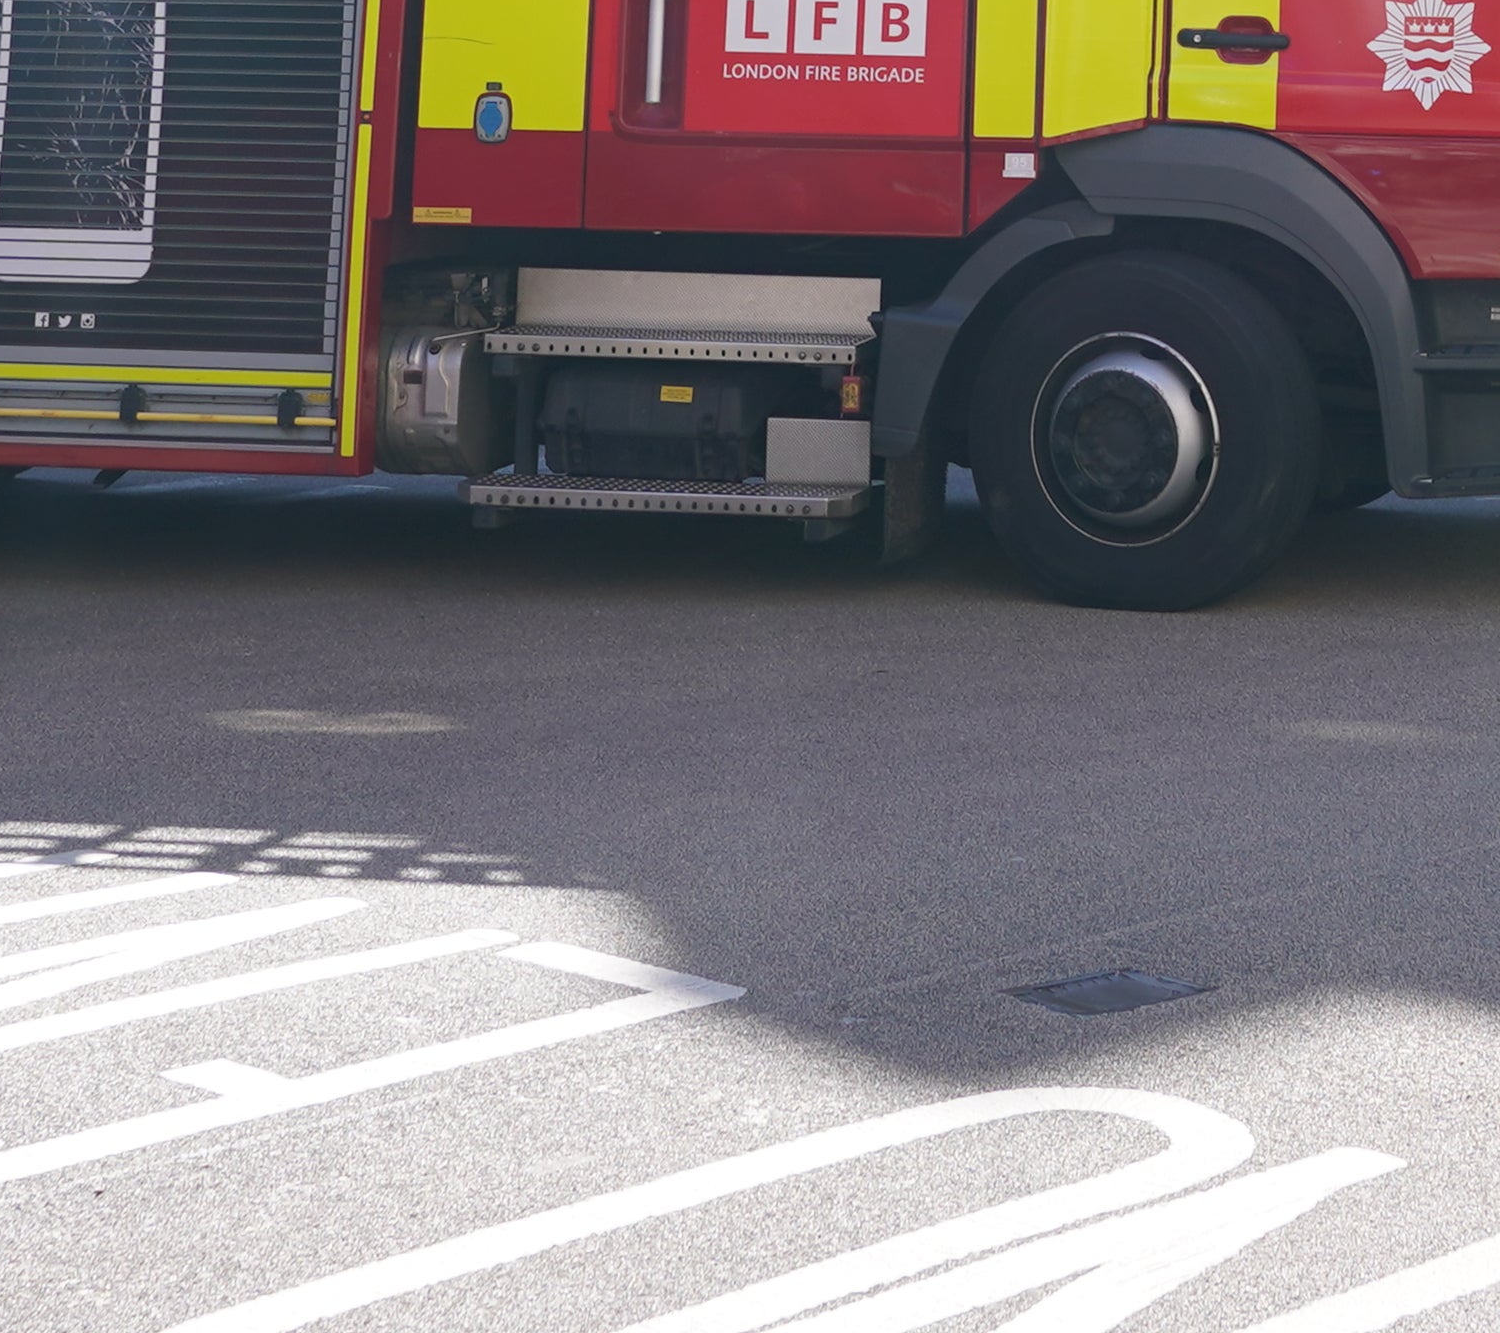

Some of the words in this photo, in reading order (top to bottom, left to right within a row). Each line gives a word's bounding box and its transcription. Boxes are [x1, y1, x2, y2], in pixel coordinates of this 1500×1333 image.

[722, 62, 799, 81] LONDON
[805, 65, 841, 82] FIRE
[847, 66, 925, 84] BRIGADE
